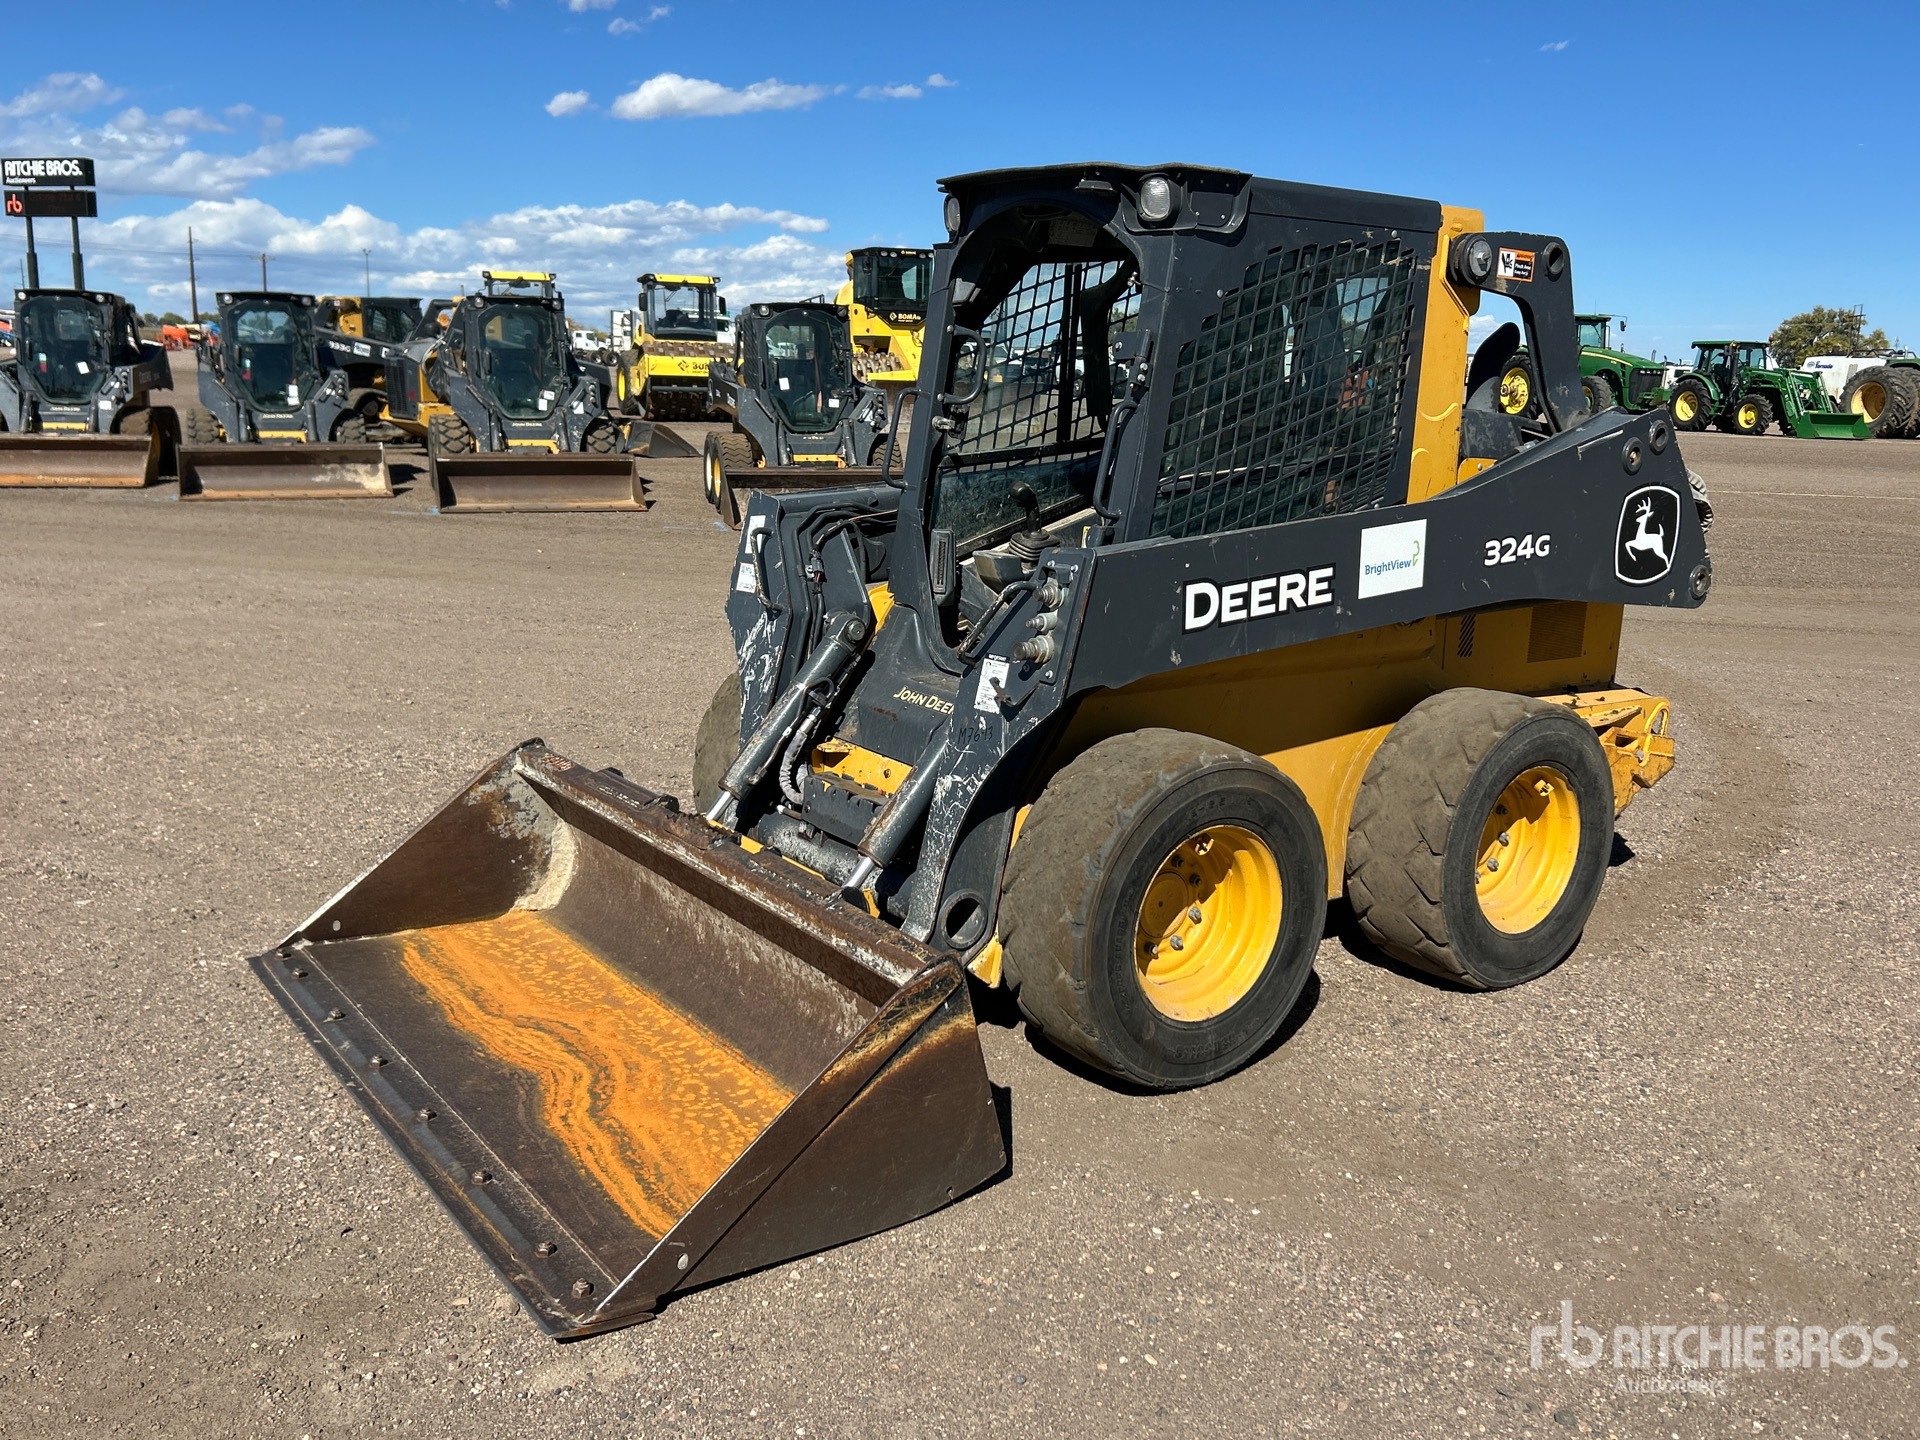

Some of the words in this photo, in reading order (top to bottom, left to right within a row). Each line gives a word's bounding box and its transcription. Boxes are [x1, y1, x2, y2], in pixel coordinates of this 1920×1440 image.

[4, 160, 45, 176] RITCHIE
[45, 159, 83, 176] BROS.
[1483, 533, 1551, 566] 324G
[1364, 558, 1412, 576] BrightView
[1184, 566, 1334, 631] DEERE
[893, 686, 928, 706] JOHN
